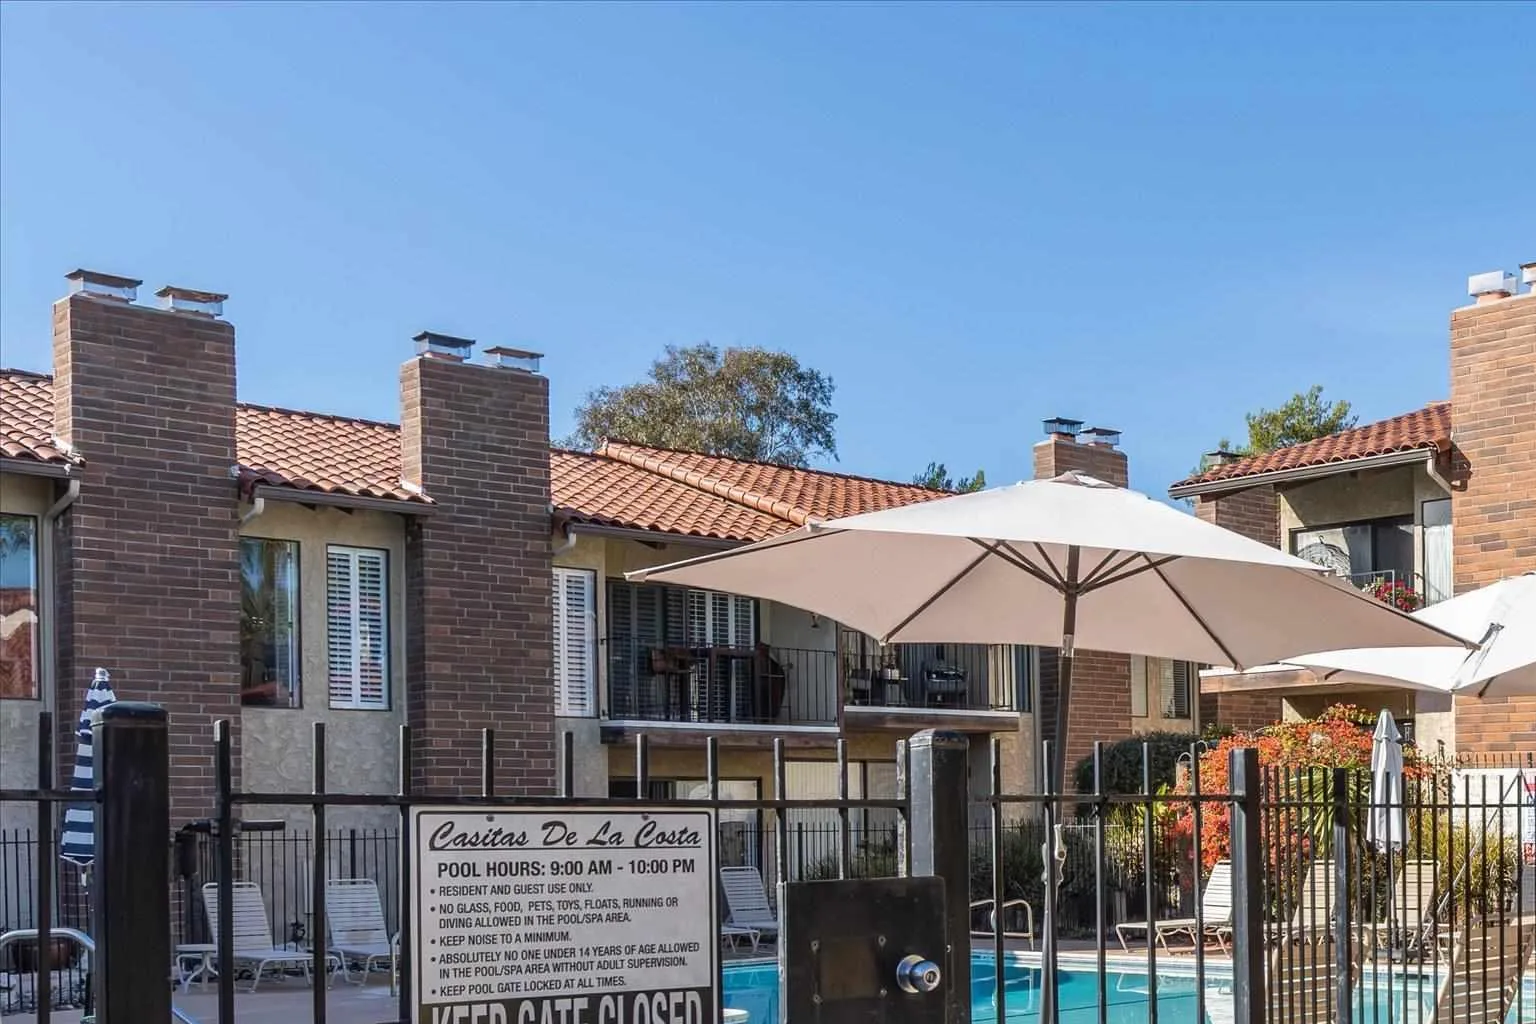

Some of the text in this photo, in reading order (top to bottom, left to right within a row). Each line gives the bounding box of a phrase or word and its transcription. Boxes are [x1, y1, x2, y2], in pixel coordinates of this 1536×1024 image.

[429, 820, 701, 848] Casitas De La Costa
[438, 862, 481, 878] POOL
[486, 861, 545, 877] HOURS:
[550, 861, 583, 876] 9:00
[587, 860, 612, 875] AM
[629, 859, 668, 874] 10:00
[673, 859, 695, 873] PM
[439, 883, 594, 897] RESIDENT AND GUEST USE ONLY.
[439, 897, 678, 914] NO GLASS, FOOD, PETS, TOYS, FLOATS, RUNNING OR
[439, 912, 632, 929] DIVING ALLOWED IN THE POOL/SPA AREA.
[439, 931, 572, 946] KEEP NOISE TO A MINIMUM.
[439, 942, 700, 964] ABSOLUTELY NO ONE UNDER 14 YEARS OF AGE ALLOWED
[439, 956, 688, 979] IN THE POOL/SPA AREA WITHOUT ADULT SUPERVISION.
[440, 976, 627, 997] KEEP POOL GATE LOCKED AT ALL TIMES.
